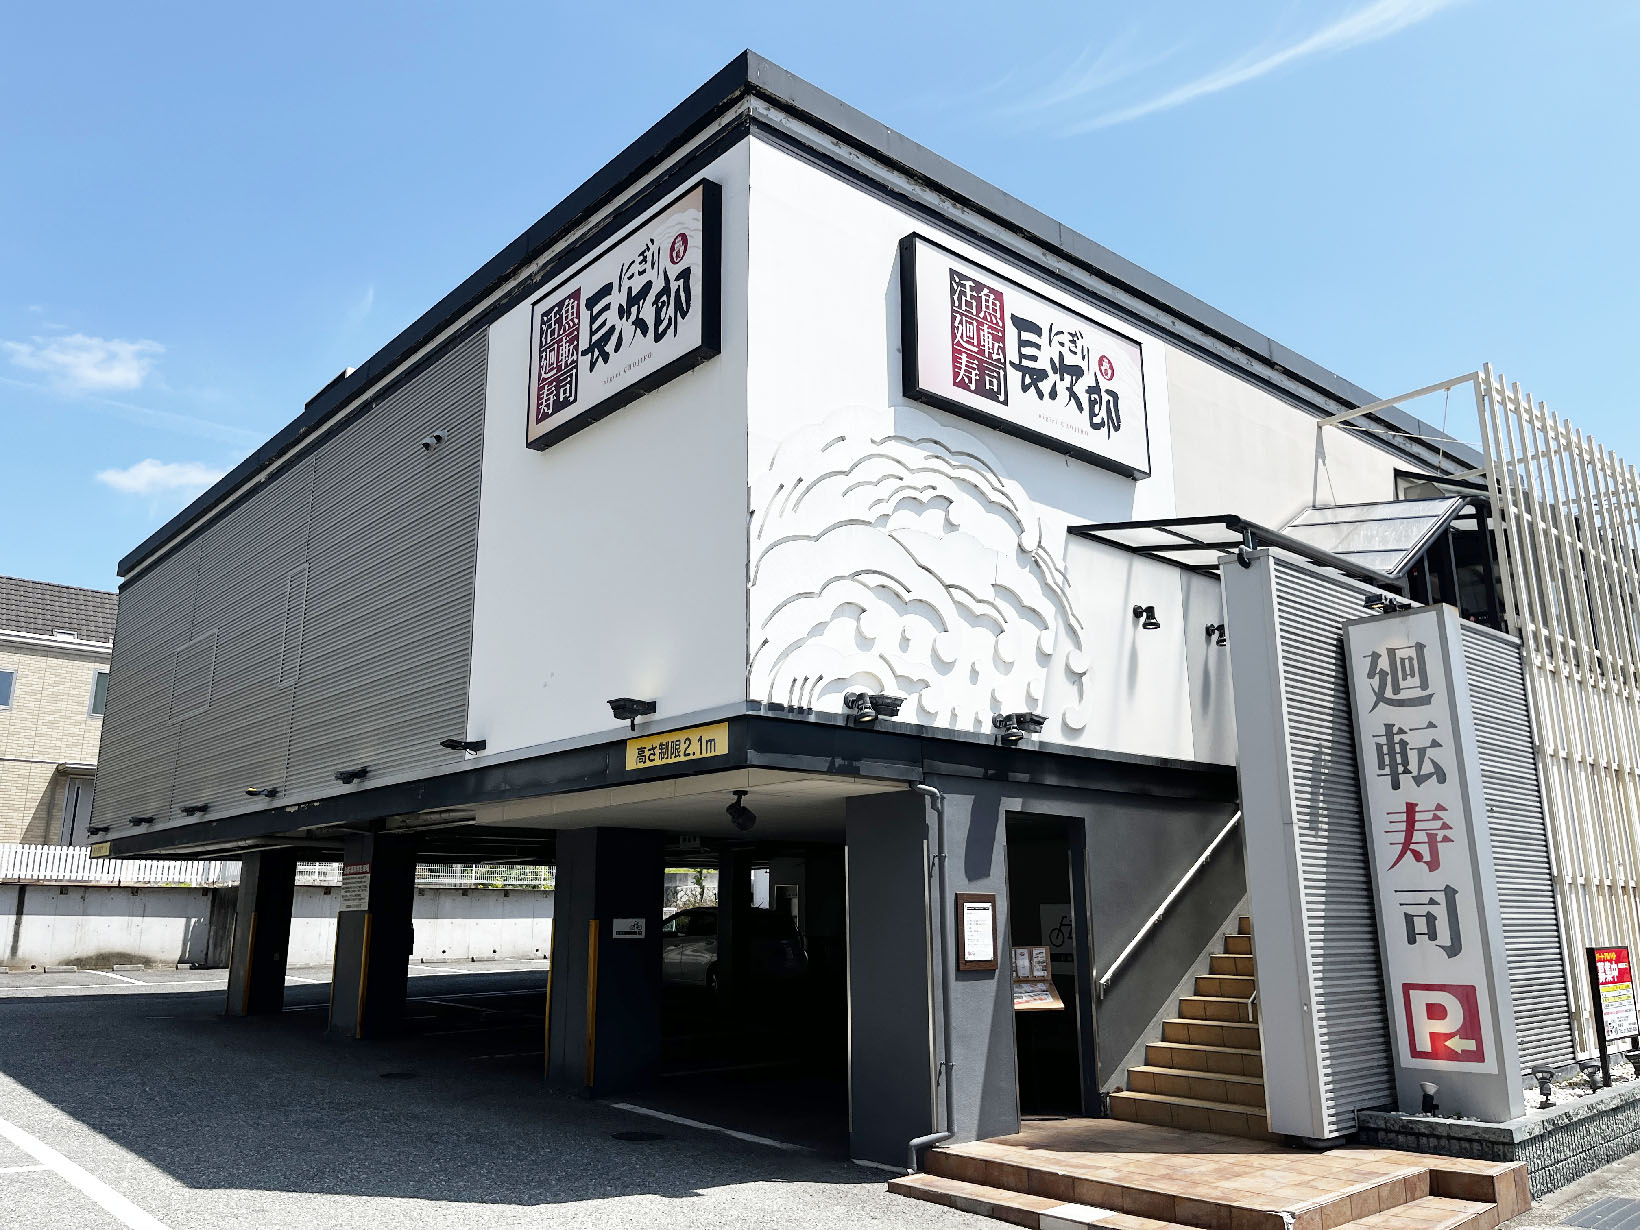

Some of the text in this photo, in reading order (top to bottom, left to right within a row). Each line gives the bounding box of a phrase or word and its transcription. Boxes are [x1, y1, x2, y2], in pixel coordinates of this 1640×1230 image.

[618, 238, 661, 294] にぎり
[541, 298, 579, 345] 活魚
[580, 265, 692, 373] 長次郎
[951, 273, 1004, 327] 活魚
[539, 330, 578, 382] 廻転
[953, 313, 1005, 364] 廻転
[1049, 322, 1090, 374] にぎり
[538, 369, 577, 419] 寿司
[954, 352, 1006, 402] 寿司
[1009, 313, 1122, 440] 長次郎
[635, 735, 717, 766] 高さ制限2.1m
[1362, 641, 1464, 960] 廻転寿司
[1409, 989, 1465, 1053] P
